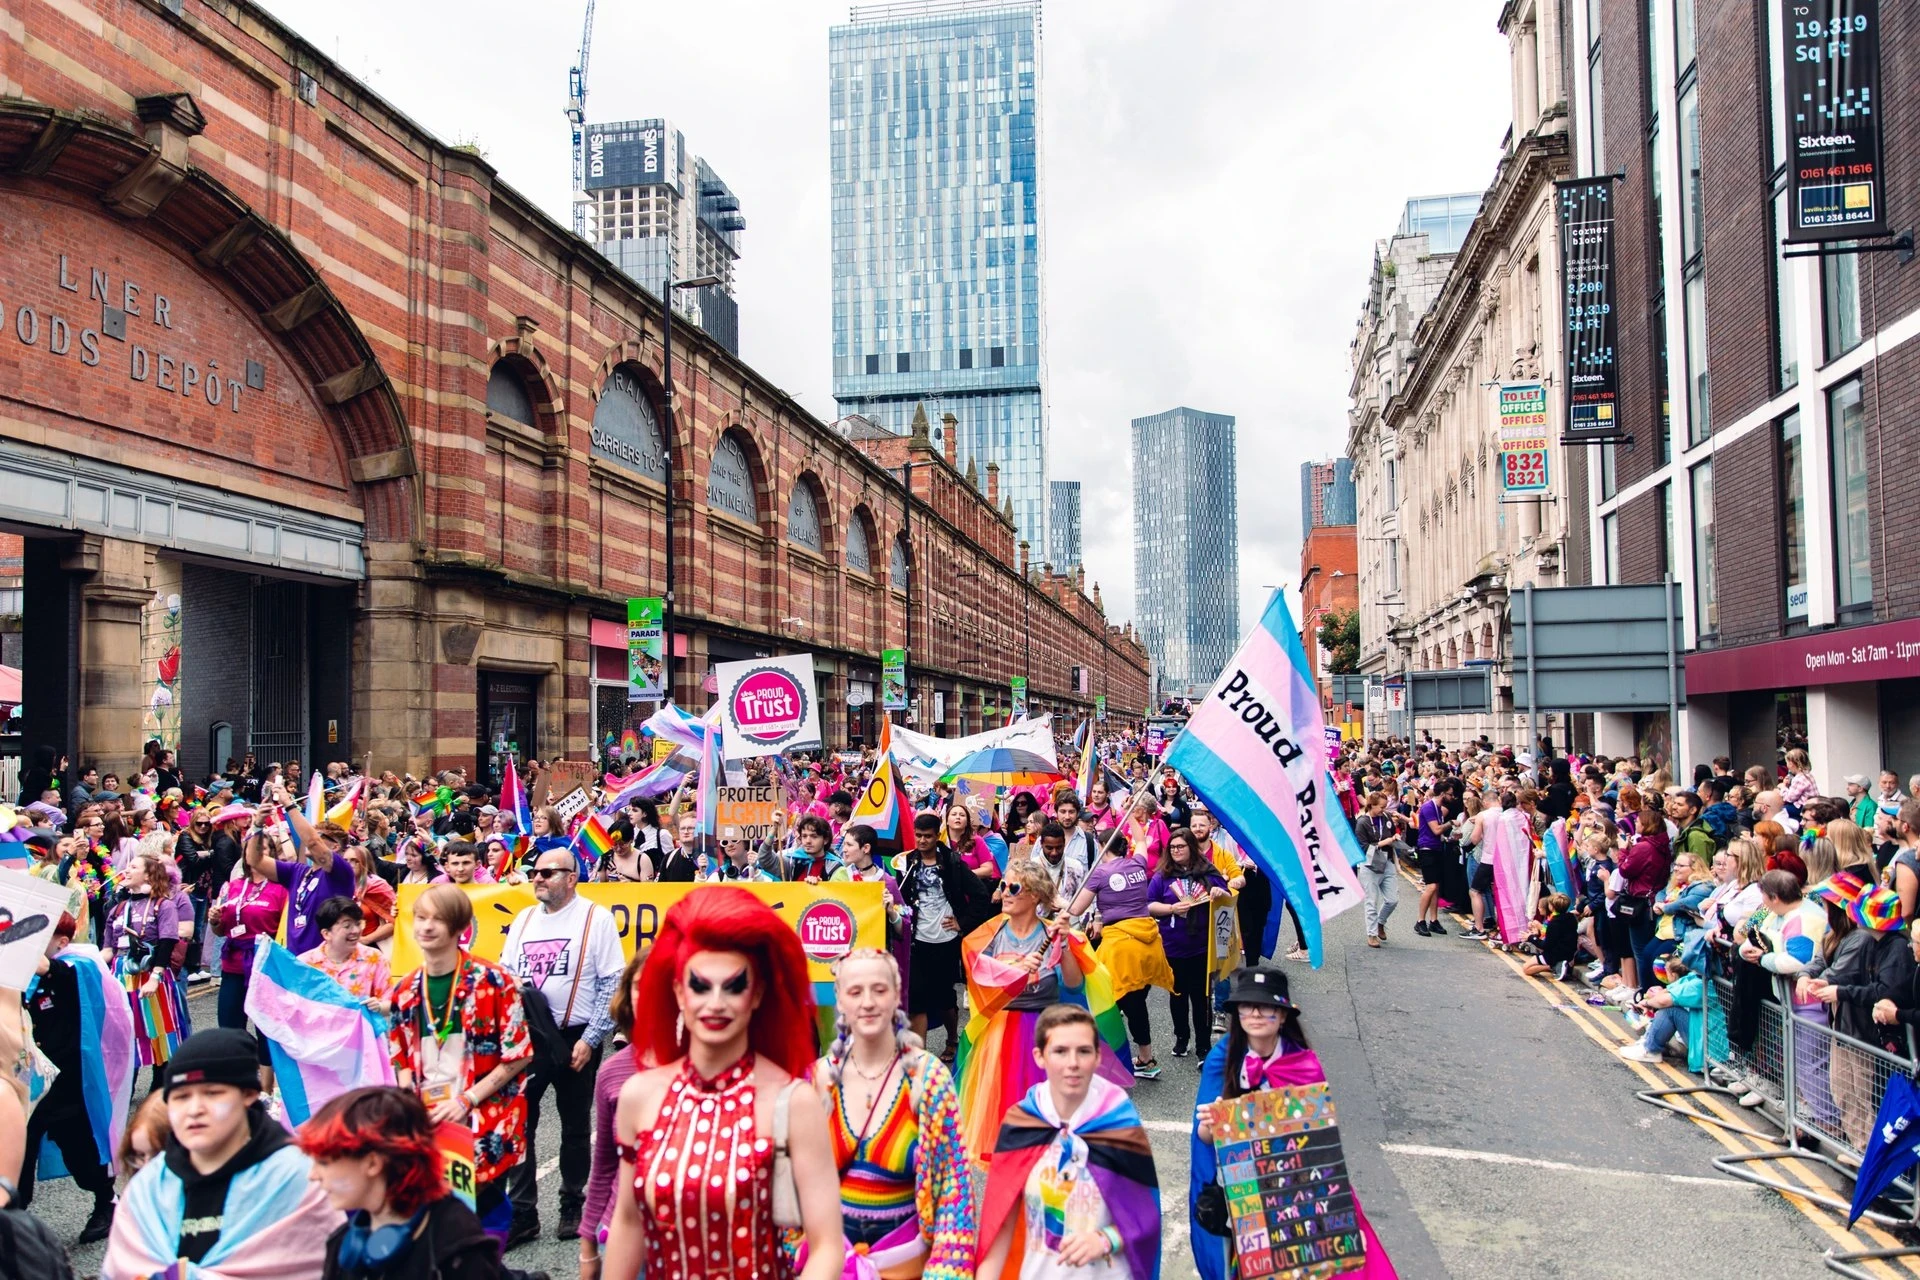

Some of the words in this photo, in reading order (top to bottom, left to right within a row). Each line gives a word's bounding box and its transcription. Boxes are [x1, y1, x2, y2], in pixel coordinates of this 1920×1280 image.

[1793, 7, 1809, 16] TO
[1795, 15, 1867, 39] 19,319
[1795, 44, 1820, 63] Sq
[1828, 41, 1850, 58] Ft
[1799, 134, 1855, 149] Sixteen.
[1800, 168, 1825, 179] 0161
[1827, 166, 1846, 177] 461
[1848, 163, 1873, 175] 1616
[1804, 216, 1825, 224] 0161
[1827, 213, 1843, 222] 236
[1845, 211, 1870, 220] 8644
[1572, 226, 1609, 236] corner
[1572, 236, 1603, 246] block
[1566, 258, 1590, 266] GRADE
[1566, 263, 1610, 273] WORKSPACE
[59, 254, 172, 329] LNER
[1567, 281, 1603, 295] 3,200
[1569, 303, 1611, 317] 19,319
[1569, 320, 1583, 332] Sq
[1586, 318, 1601, 329] Ft
[0, 299, 100, 366] ODS
[130, 344, 244, 413] DEPÔT
[1571, 374, 1605, 383] Sixteen.
[1503, 392, 1517, 401] TO
[1520, 390, 1540, 400] LET
[1501, 401, 1544, 414] OFFICES
[1502, 414, 1544, 426] OFFICES
[1503, 427, 1546, 439] OFFICES
[591, 425, 641, 466] CARRIERS
[642, 452, 658, 472] TO
[1503, 439, 1546, 451] OFFICES
[1506, 452, 1544, 471] 832
[727, 470, 742, 487] THE
[1507, 470, 1545, 486] 8321
[631, 630, 660, 638] PARADE
[1805, 653, 1826, 671] Open
[1827, 650, 1845, 666] Mon
[1851, 646, 1867, 663] Sat
[1868, 645, 1888, 661] 7am
[1896, 641, 1920, 662] 11pm
[757, 686, 783, 699] PROUD
[741, 694, 793, 720] Trust
[1217, 668, 1303, 769] Proud
[719, 786, 782, 803] PROTECT
[818, 916, 841, 926] PROUD
[806, 921, 847, 941] Trust
[519, 959, 568, 978] HATE
[1240, 1231, 1265, 1254] SAT
